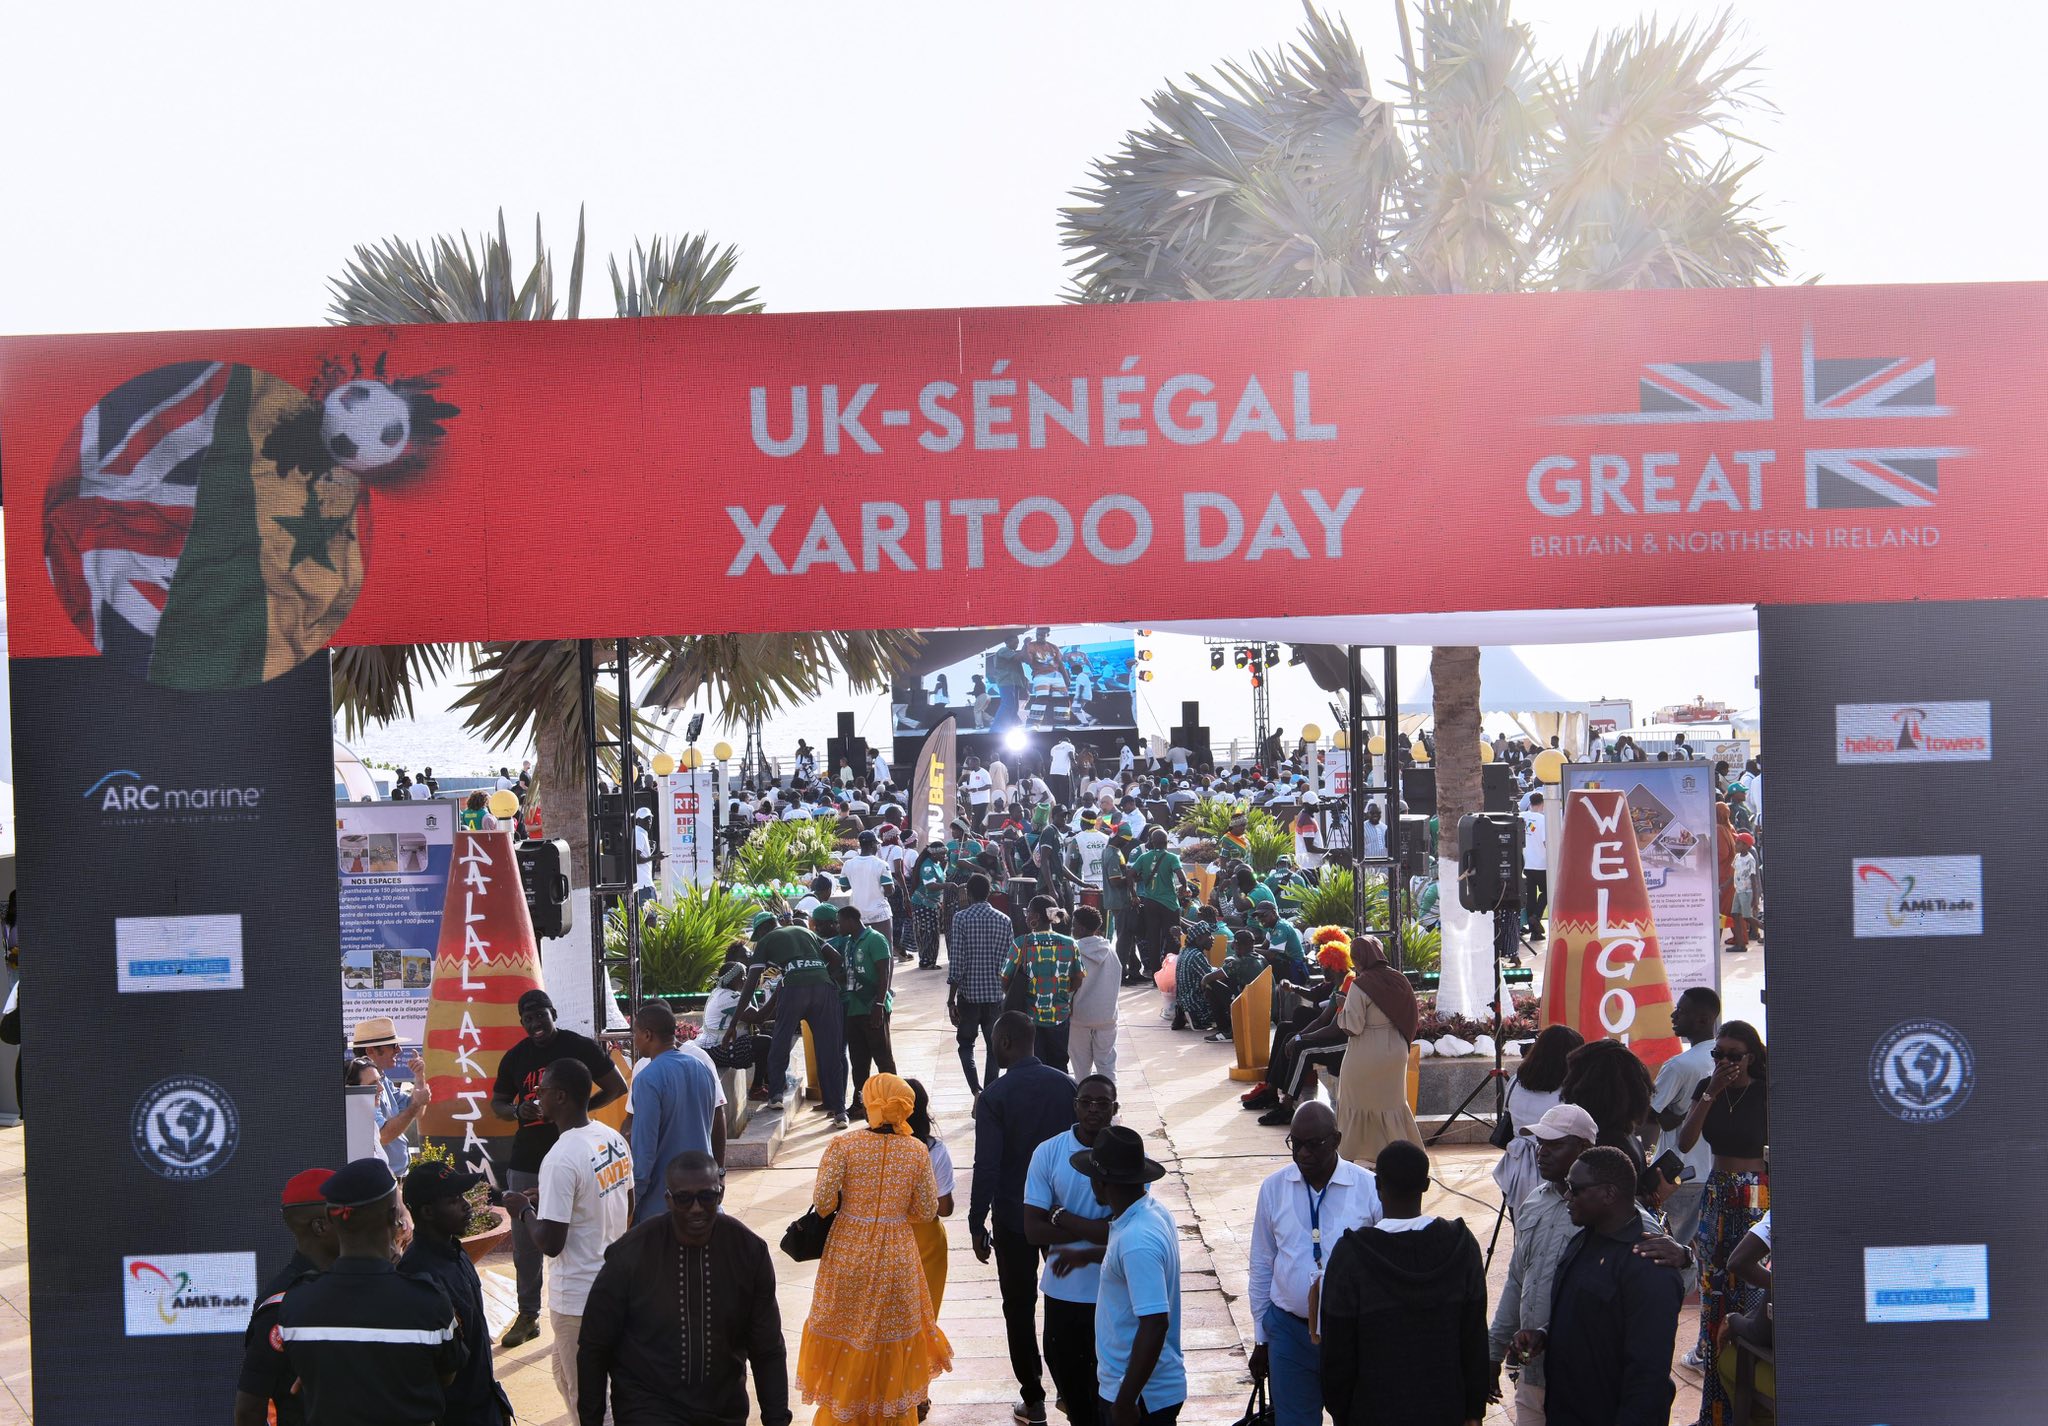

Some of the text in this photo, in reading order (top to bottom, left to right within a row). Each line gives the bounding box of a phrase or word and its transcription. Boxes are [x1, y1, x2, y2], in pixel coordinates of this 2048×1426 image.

[749, 356, 1338, 458] UK-SÉNÉGAL
[1526, 449, 1776, 517] GREAT
[724, 487, 1366, 577] XARITOO DAY
[1530, 526, 1941, 558] BRITAIN & NORTHERN IRELAND
[1844, 735, 1985, 753] helios towers
[1335, 777, 1352, 788] RT
[102, 784, 260, 811] ARC marine
[675, 798, 699, 810] RTS
[928, 752, 945, 843] NUBET
[369, 877, 402, 885] ESPACES
[1898, 898, 1975, 913] AMETrade
[383, 919, 395, 927] plus
[417, 918, 434, 926] places
[1579, 795, 1646, 1050] WELCO
[363, 927, 375, 935] jeux
[340, 943, 360, 951] parking
[375, 990, 411, 998] SERVICES
[413, 998, 429, 1006] grand
[1901, 1108, 1945, 1121] DAKAR
[163, 1165, 209, 1178] DAKAR
[172, 1295, 250, 1309] AMETrade
